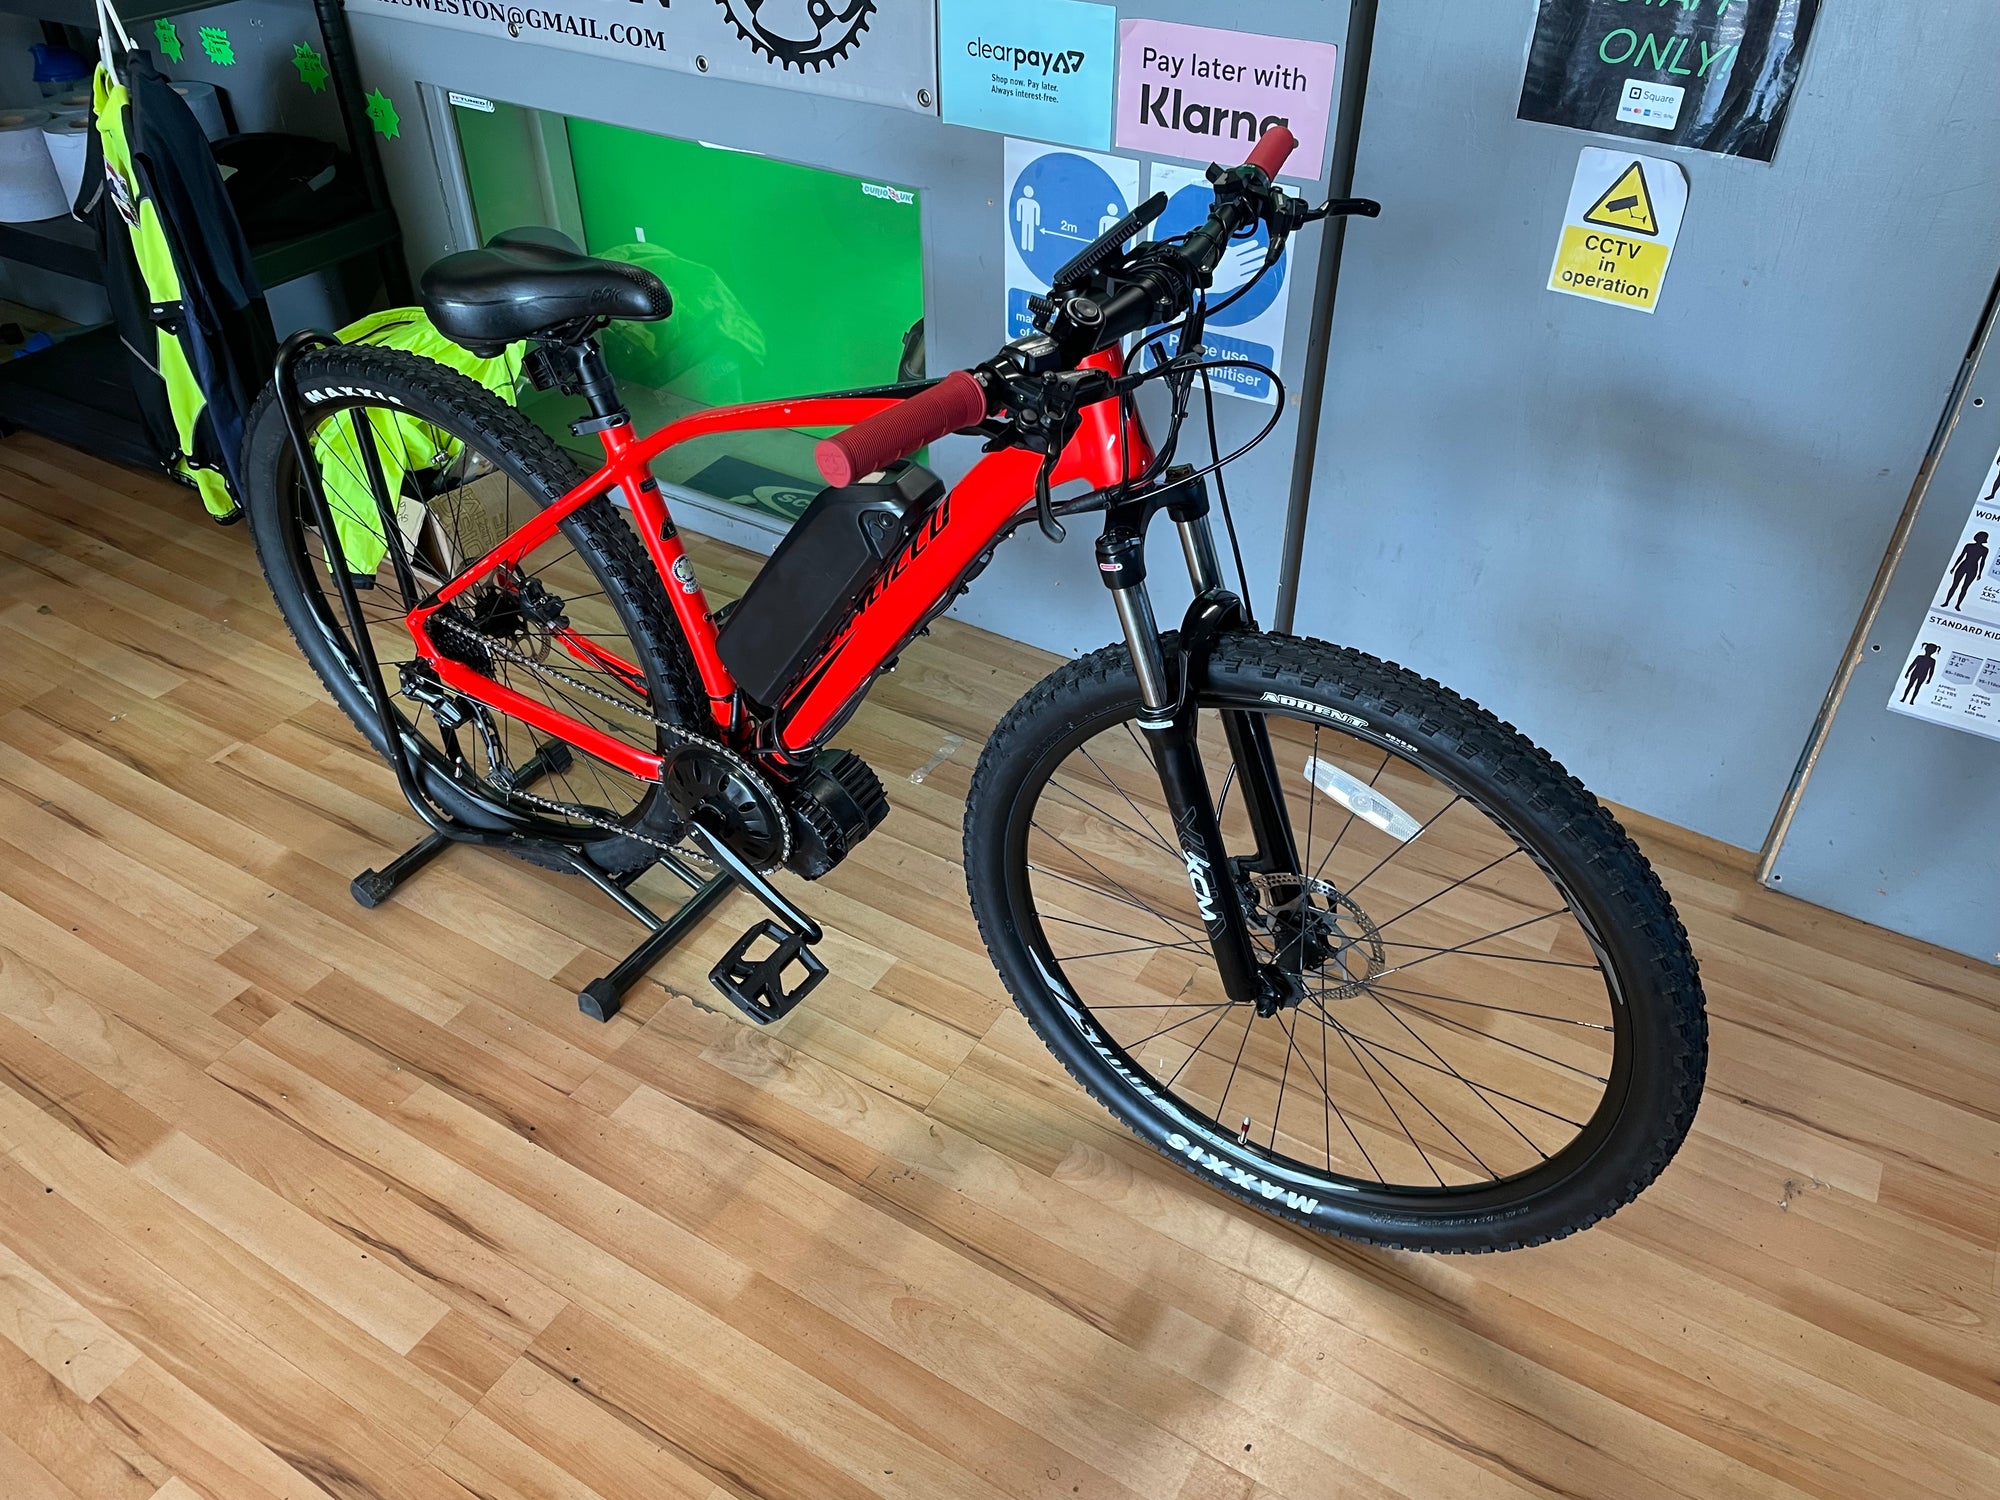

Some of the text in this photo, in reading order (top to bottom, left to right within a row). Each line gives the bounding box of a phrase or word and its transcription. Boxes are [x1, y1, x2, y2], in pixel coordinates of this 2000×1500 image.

[967, 36, 1053, 76] clearpay
[1598, 28, 1739, 80] ONLY!
[1143, 47, 1307, 91] Pay later with
[991, 74, 1059, 92] Shop now. Pay later.
[991, 85, 1059, 103] Always interest-free.
[1643, 90, 1675, 103] Square
[1060, 220, 1078, 233] 2m
[1585, 235, 1641, 259] CCTV
[1598, 256, 1615, 273] in
[1561, 270, 1649, 299] operation
[1221, 348, 1248, 361] use
[1198, 366, 1261, 387] anitiser
[1929, 616, 1983, 636] STANDARD
[1181, 848, 1217, 921] XCM
[1165, 1133, 1319, 1215] MAXXIS
